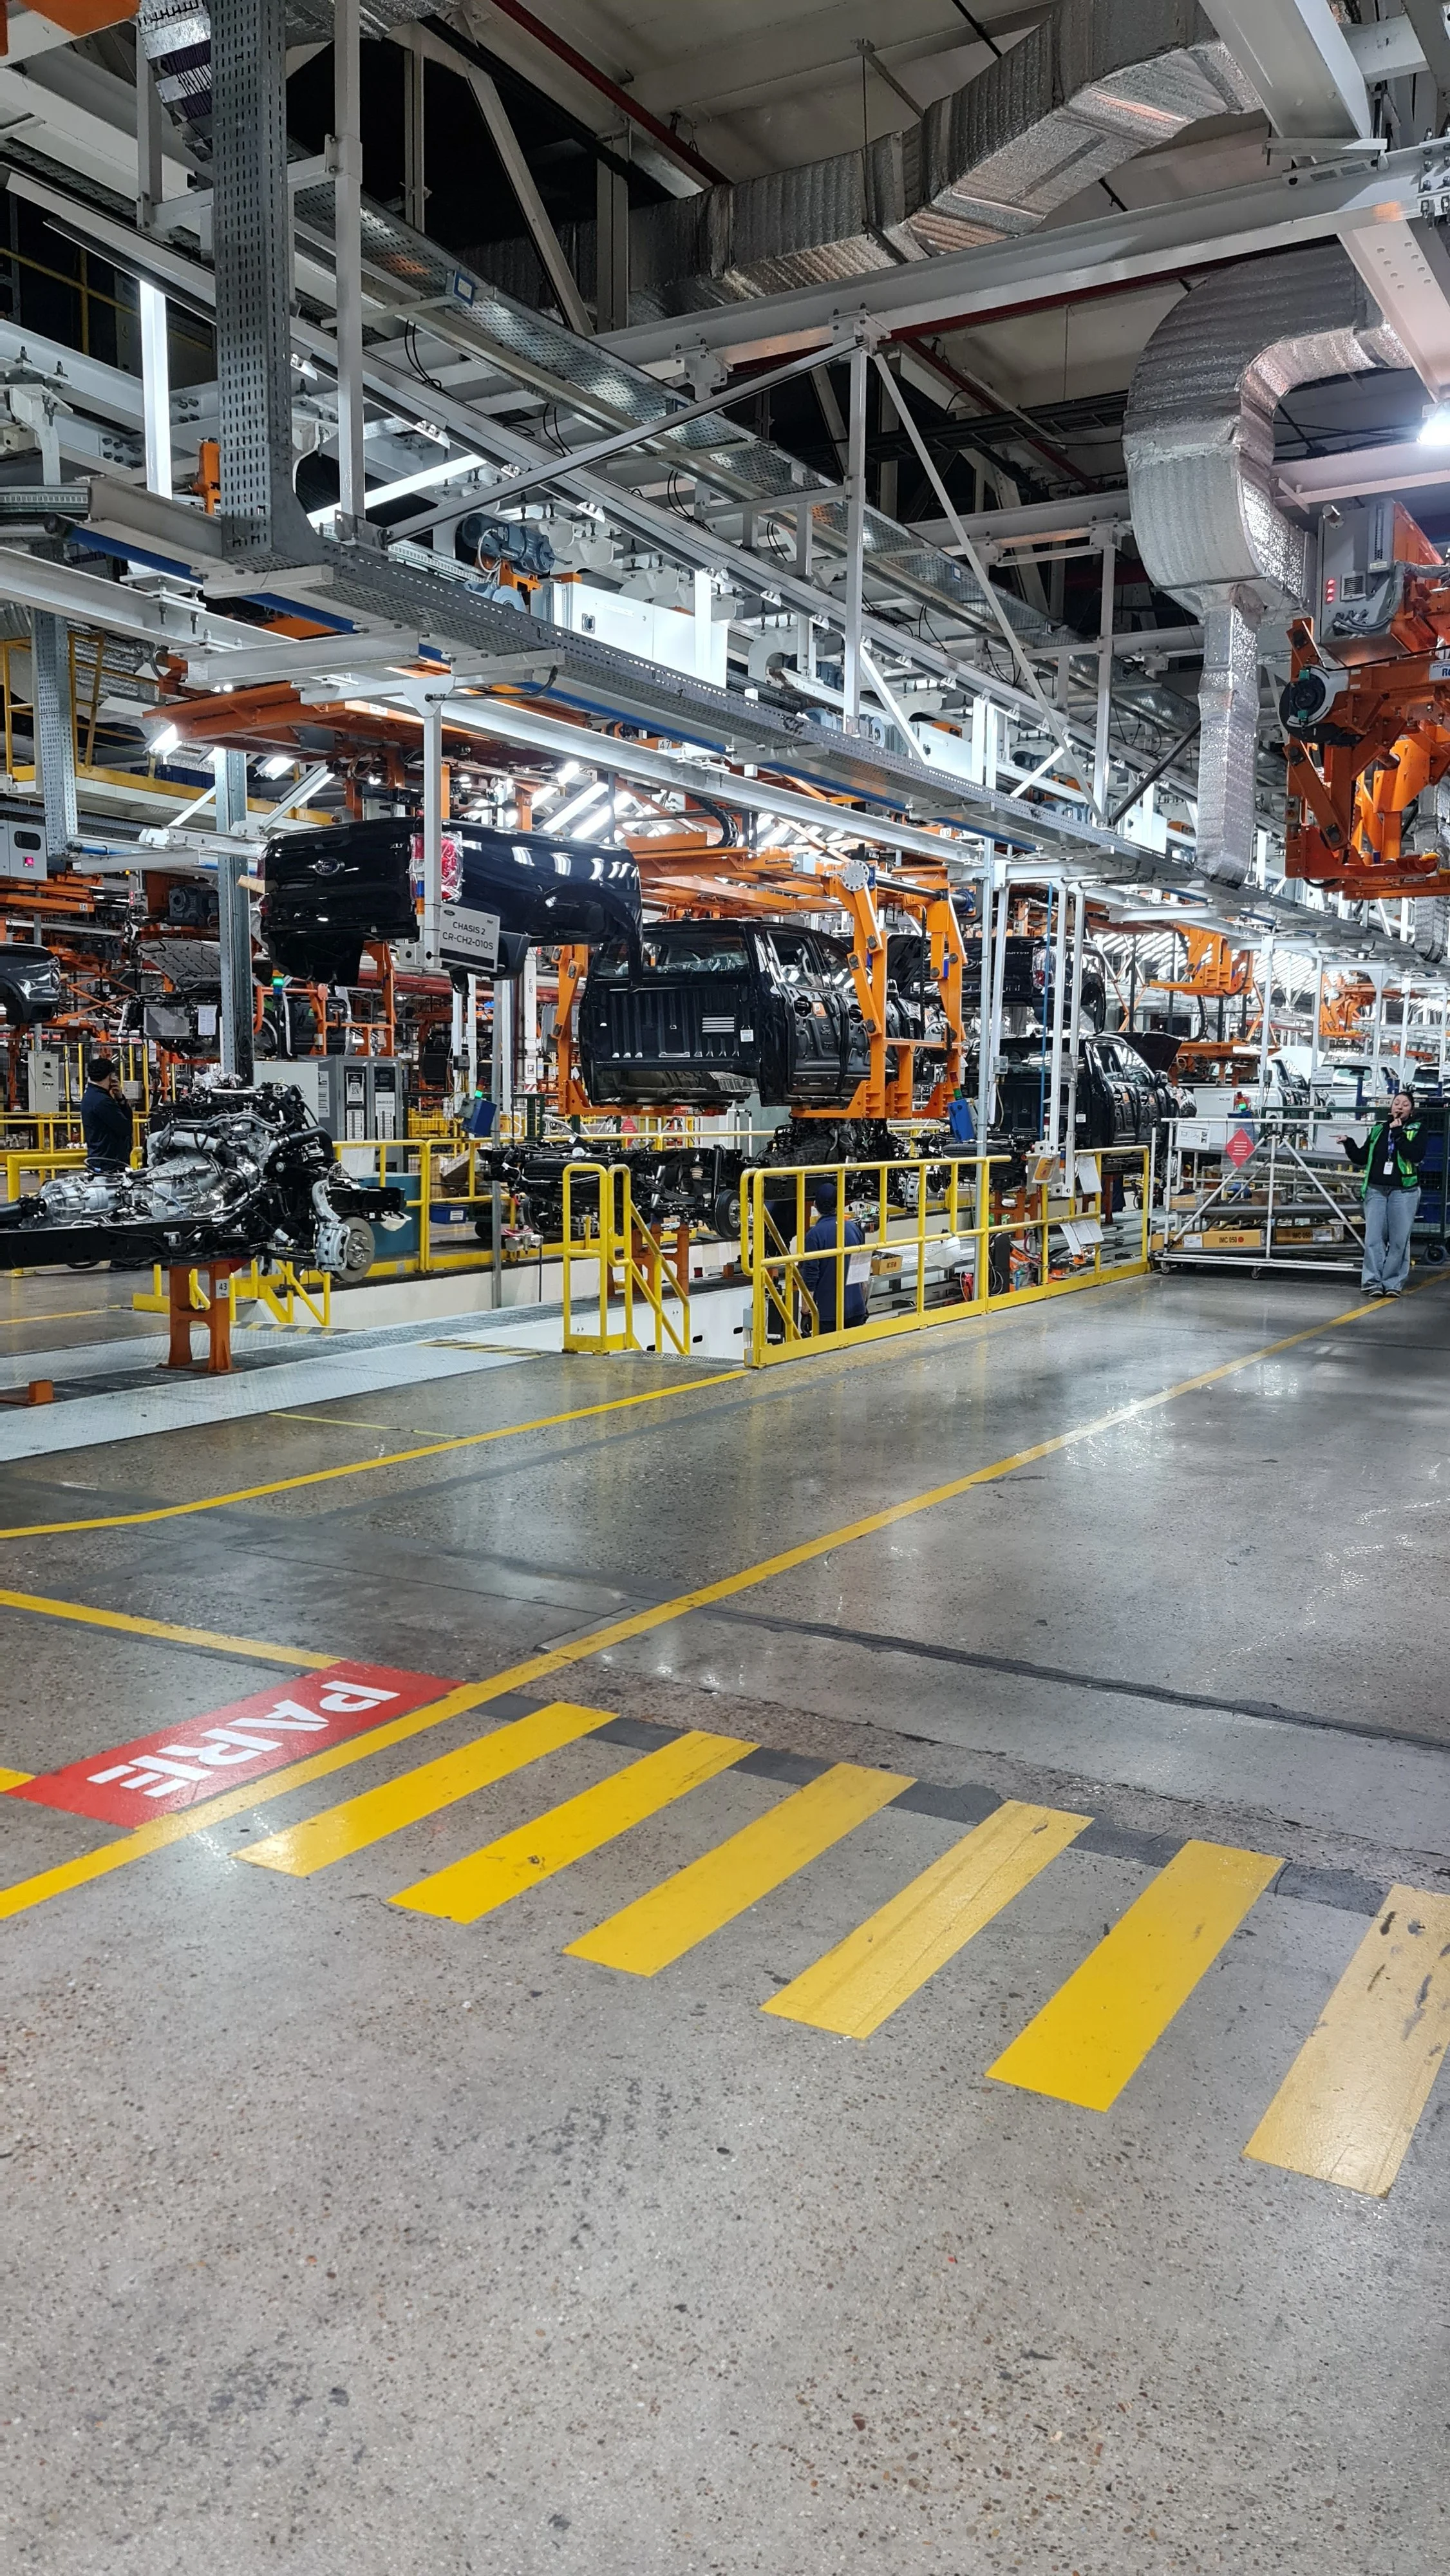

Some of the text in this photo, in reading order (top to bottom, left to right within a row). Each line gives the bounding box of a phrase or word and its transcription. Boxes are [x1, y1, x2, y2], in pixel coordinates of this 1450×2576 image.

[453, 922, 480, 934] CHASIS
[442, 932, 494, 950] CR-CH2-010S
[219, 1282, 227, 1291] 43
[87, 1680, 400, 1797] PARE
